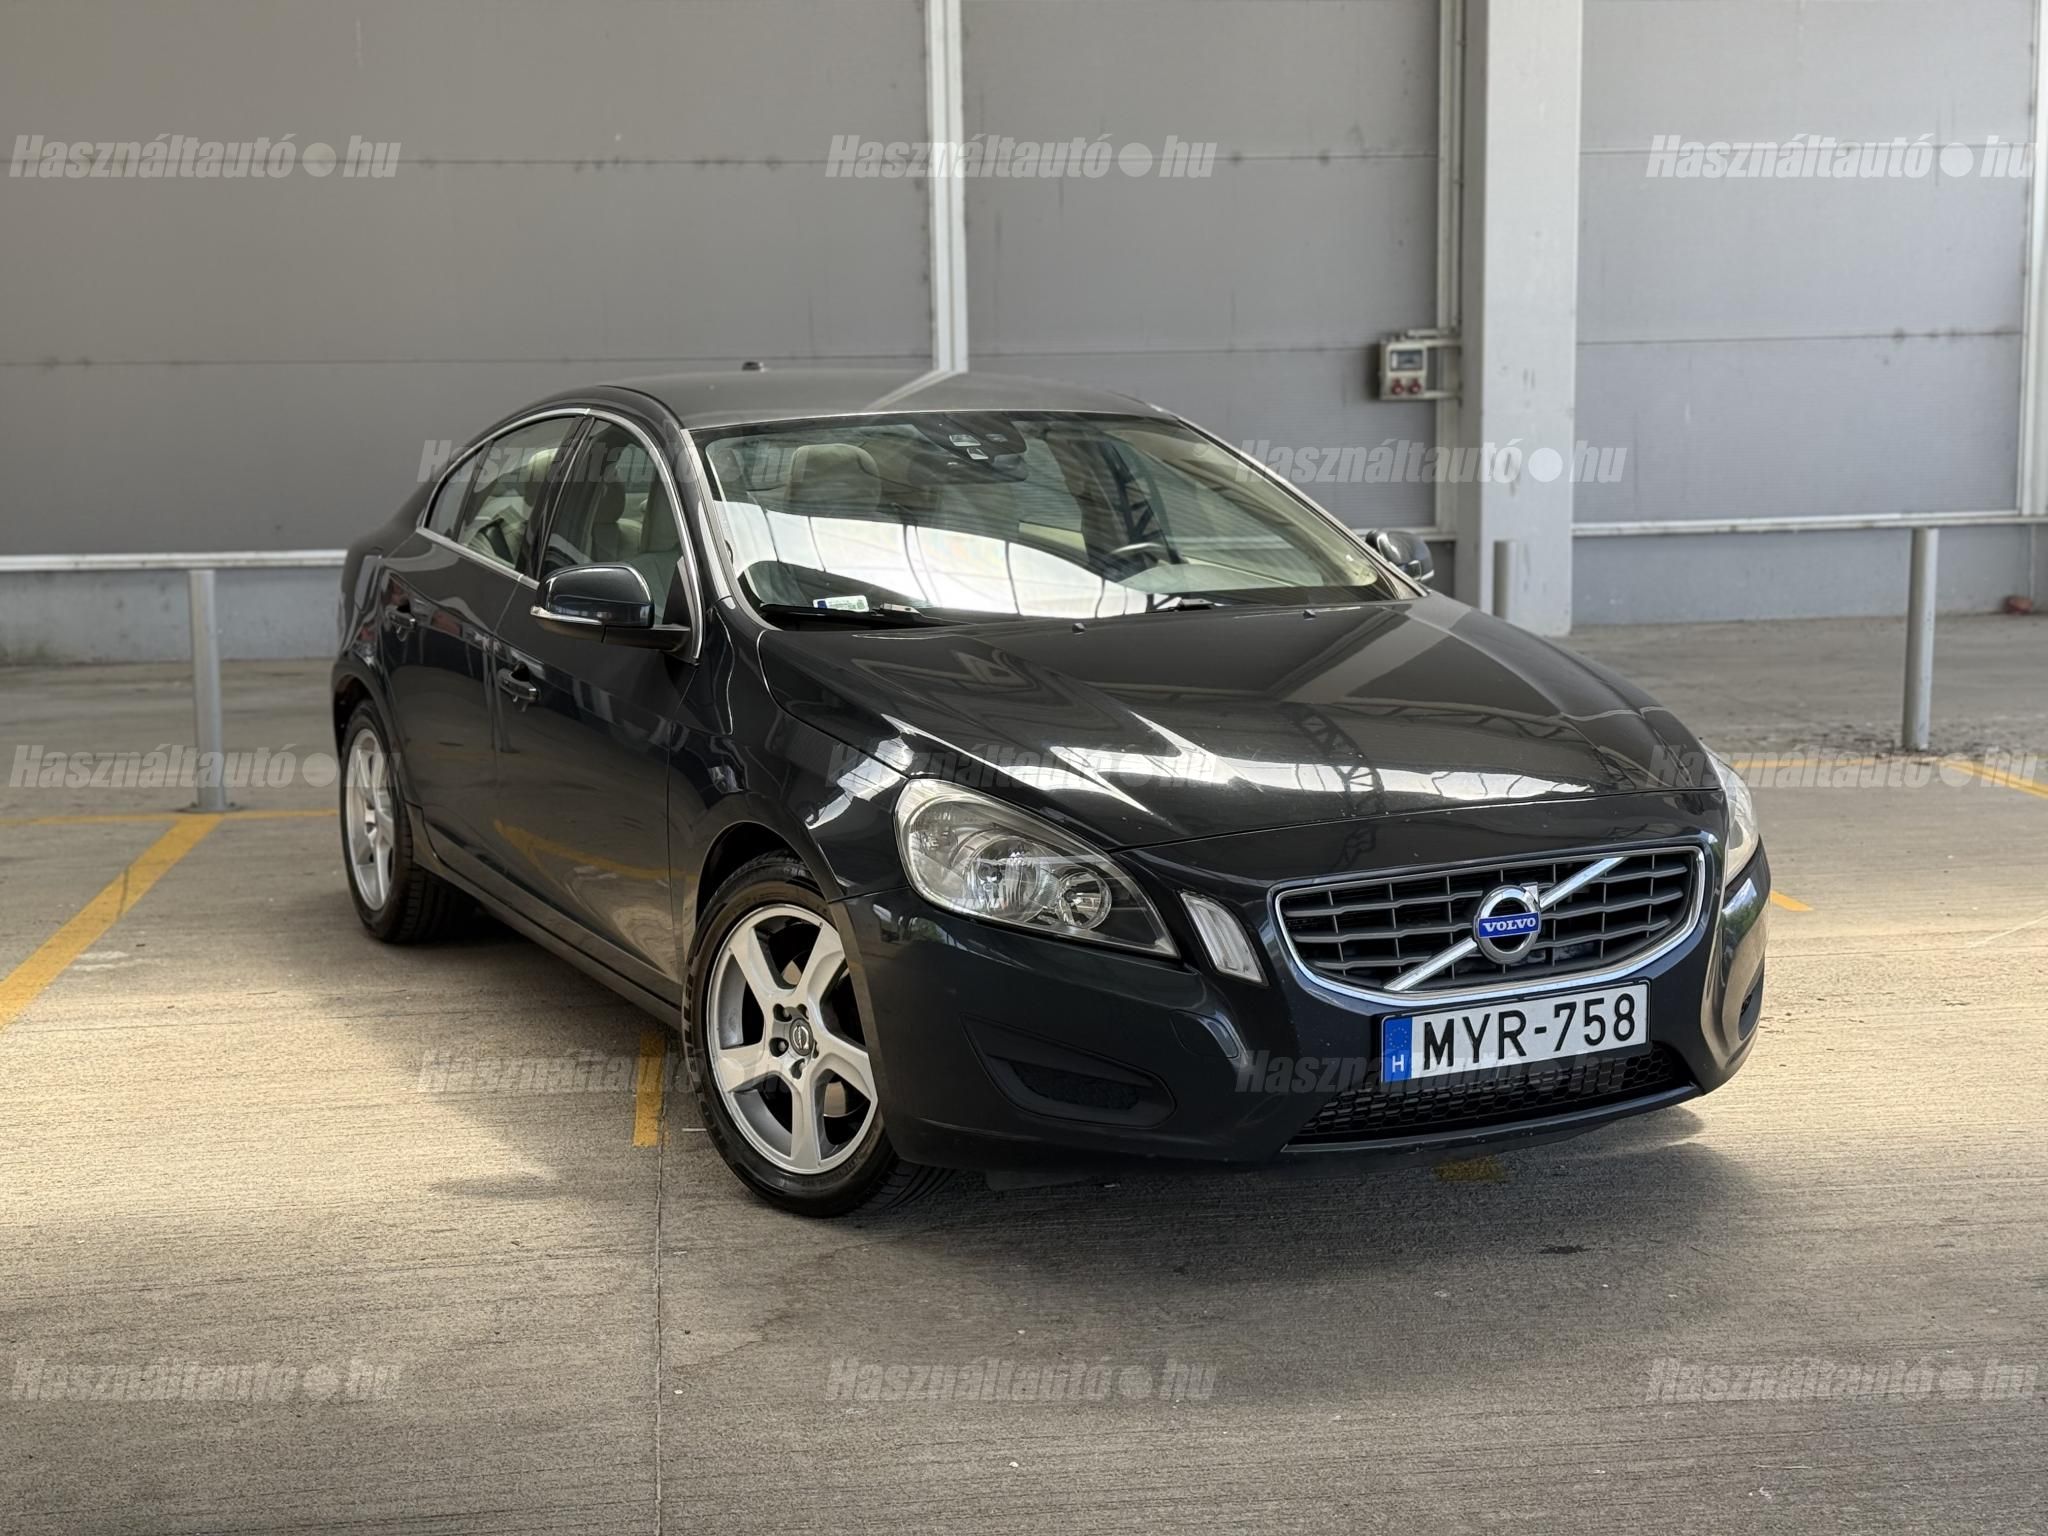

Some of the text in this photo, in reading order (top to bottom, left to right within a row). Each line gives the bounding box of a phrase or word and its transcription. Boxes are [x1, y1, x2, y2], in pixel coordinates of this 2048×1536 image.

[1482, 917, 1537, 933] VOLVO
[1422, 992, 1636, 1071] MYR-758
[1391, 1053, 1405, 1074] H
